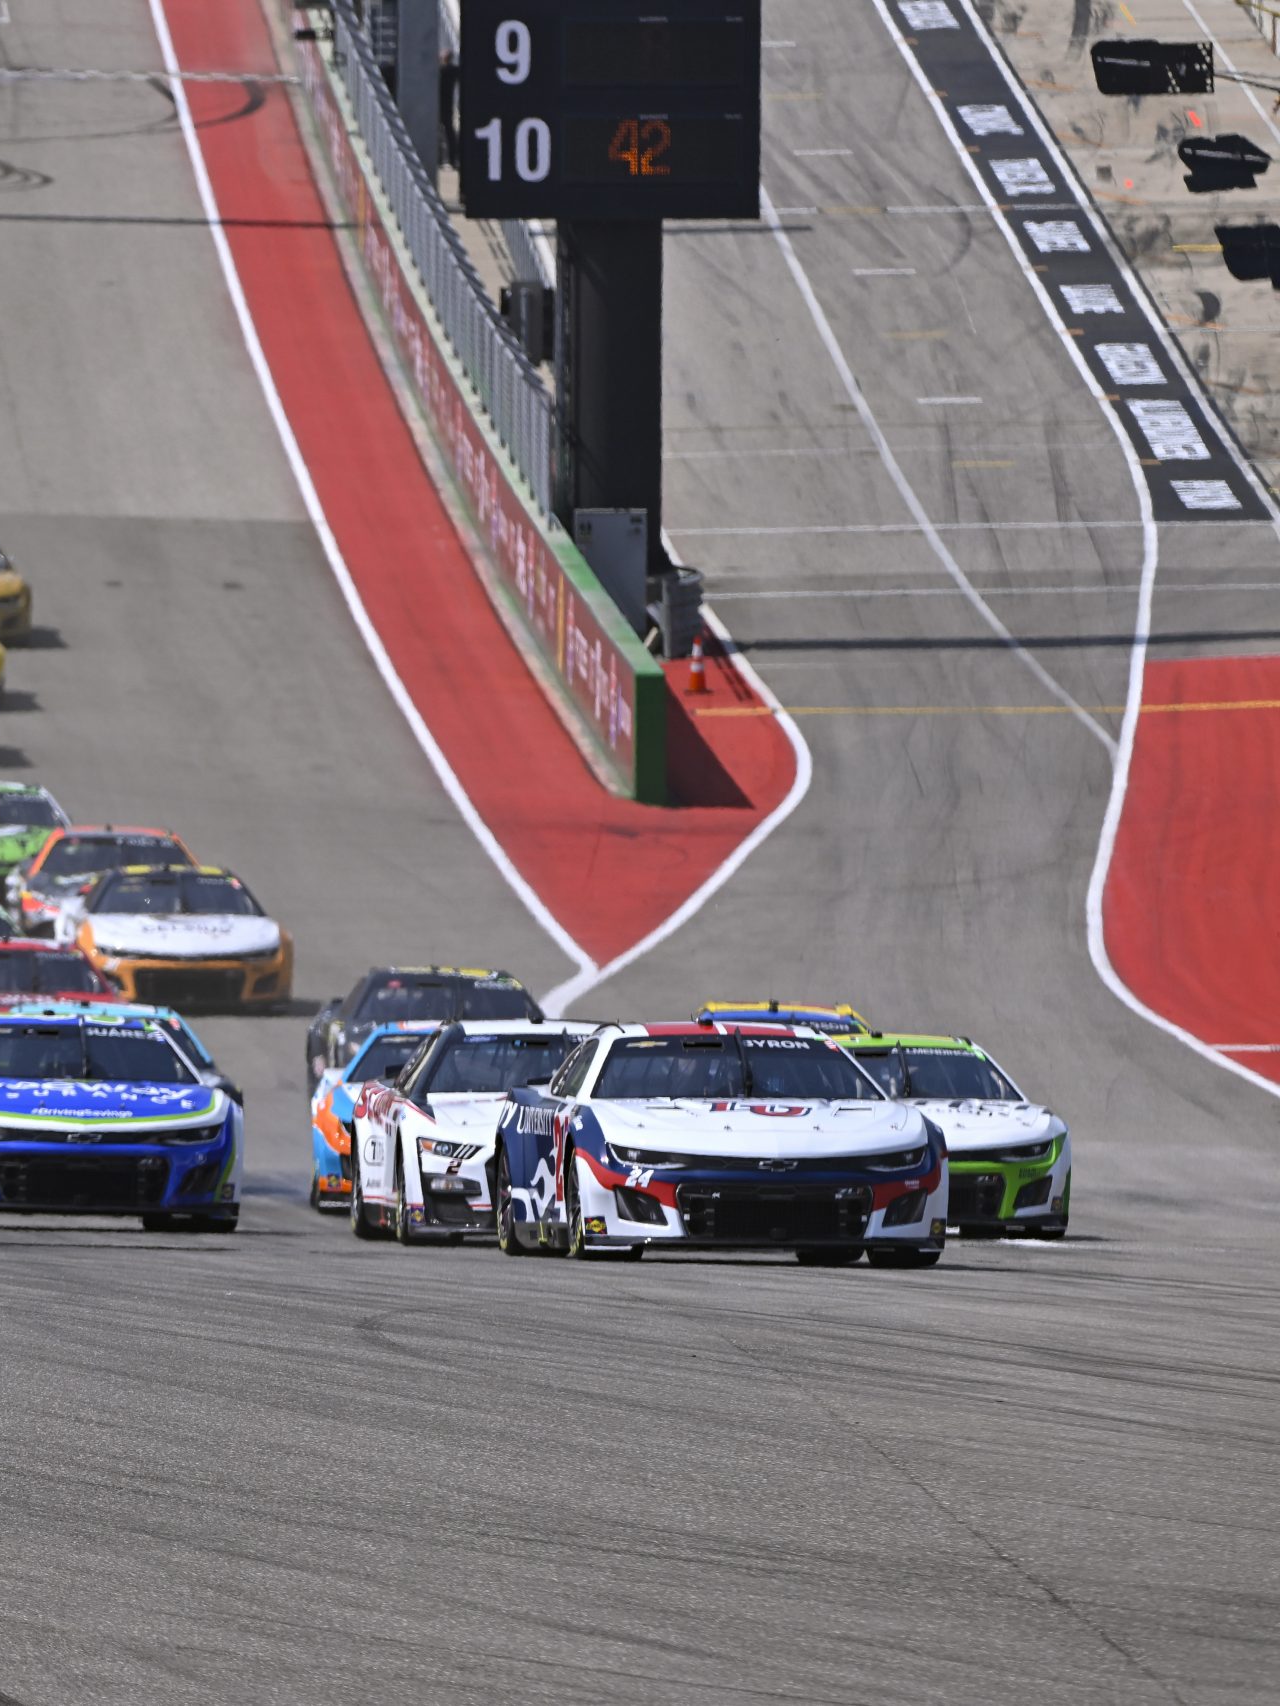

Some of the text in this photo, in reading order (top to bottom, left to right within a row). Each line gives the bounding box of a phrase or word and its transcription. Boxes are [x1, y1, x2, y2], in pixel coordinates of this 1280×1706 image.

[495, 20, 531, 84] 9
[474, 117, 551, 182] 10
[608, 119, 672, 176] 42
[625, 1165, 654, 1188] 24
